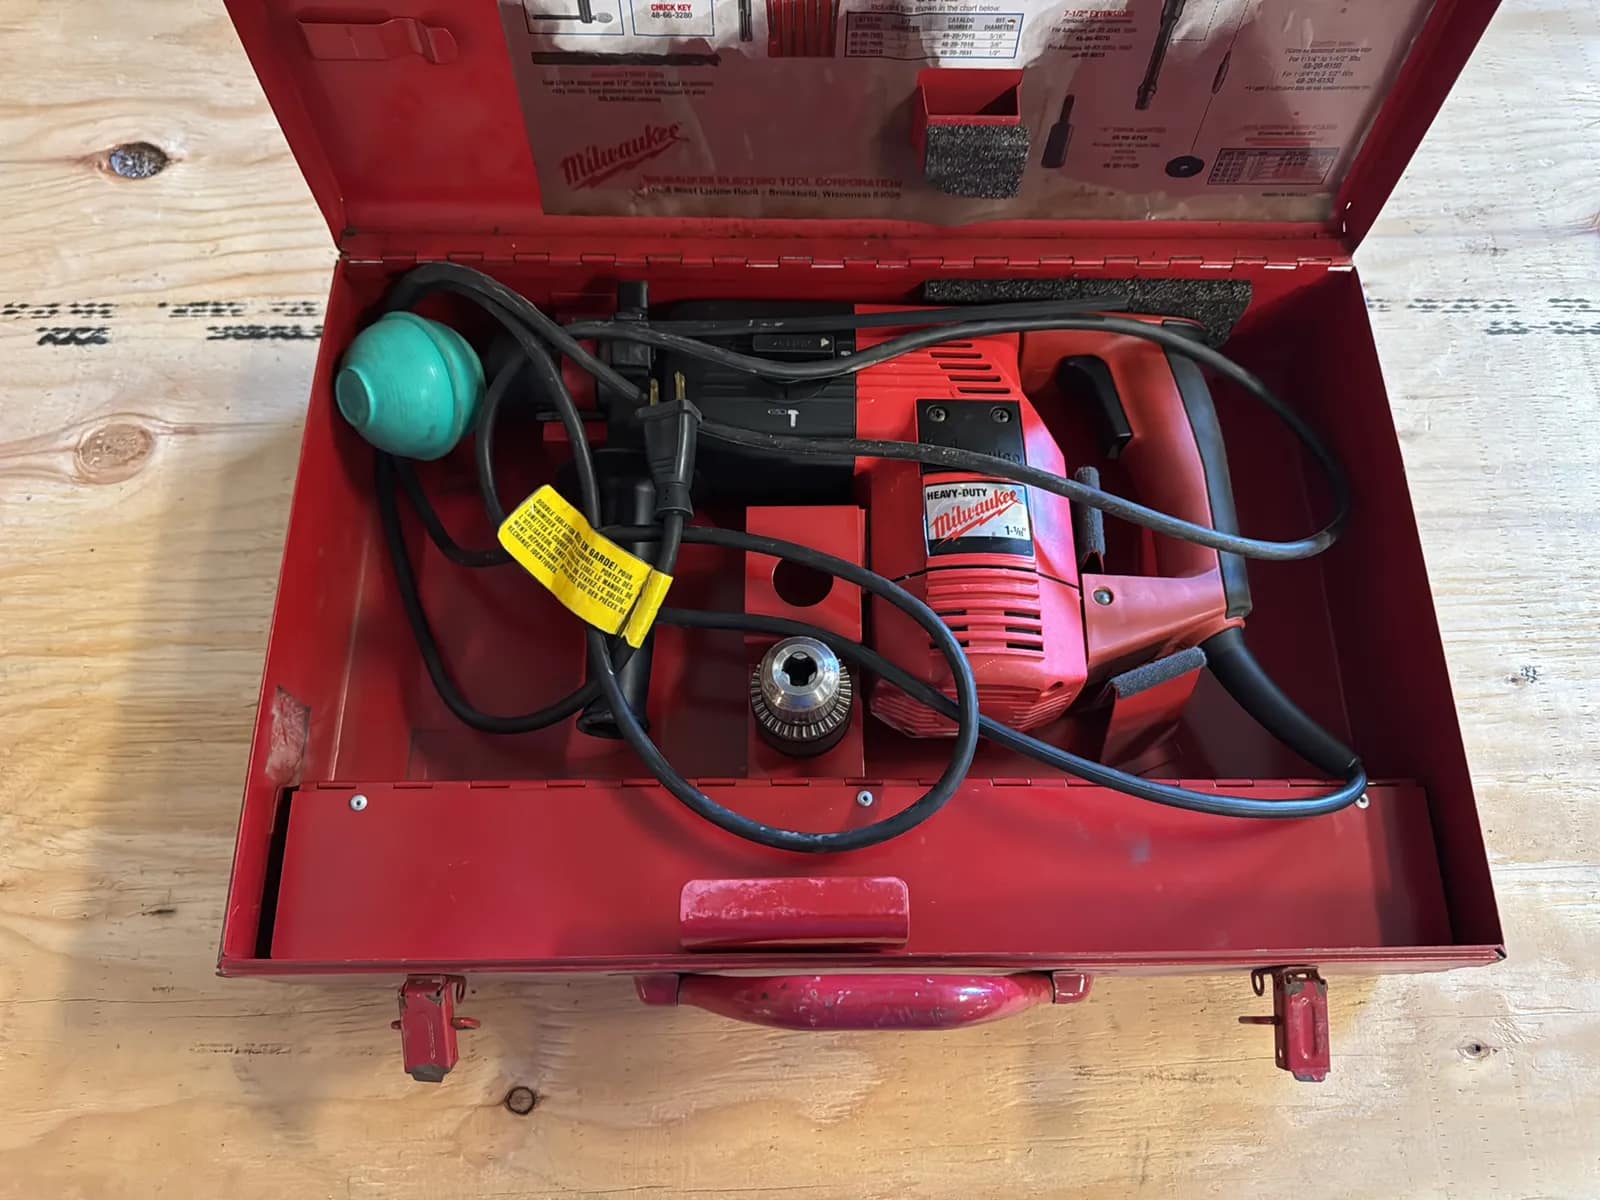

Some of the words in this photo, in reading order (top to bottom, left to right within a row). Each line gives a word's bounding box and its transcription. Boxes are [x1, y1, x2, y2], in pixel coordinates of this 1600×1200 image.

[650, 3, 676, 11] CHUCK
[677, 3, 692, 11] KEY
[780, 177, 811, 187] TOOL
[927, 488, 987, 500] HEAVY-DUTY
[930, 489, 1019, 538] Milwaukee
[589, 549, 617, 570] GARDE!
[600, 567, 621, 583] PORTEZ
[602, 578, 624, 594] MANUEL
